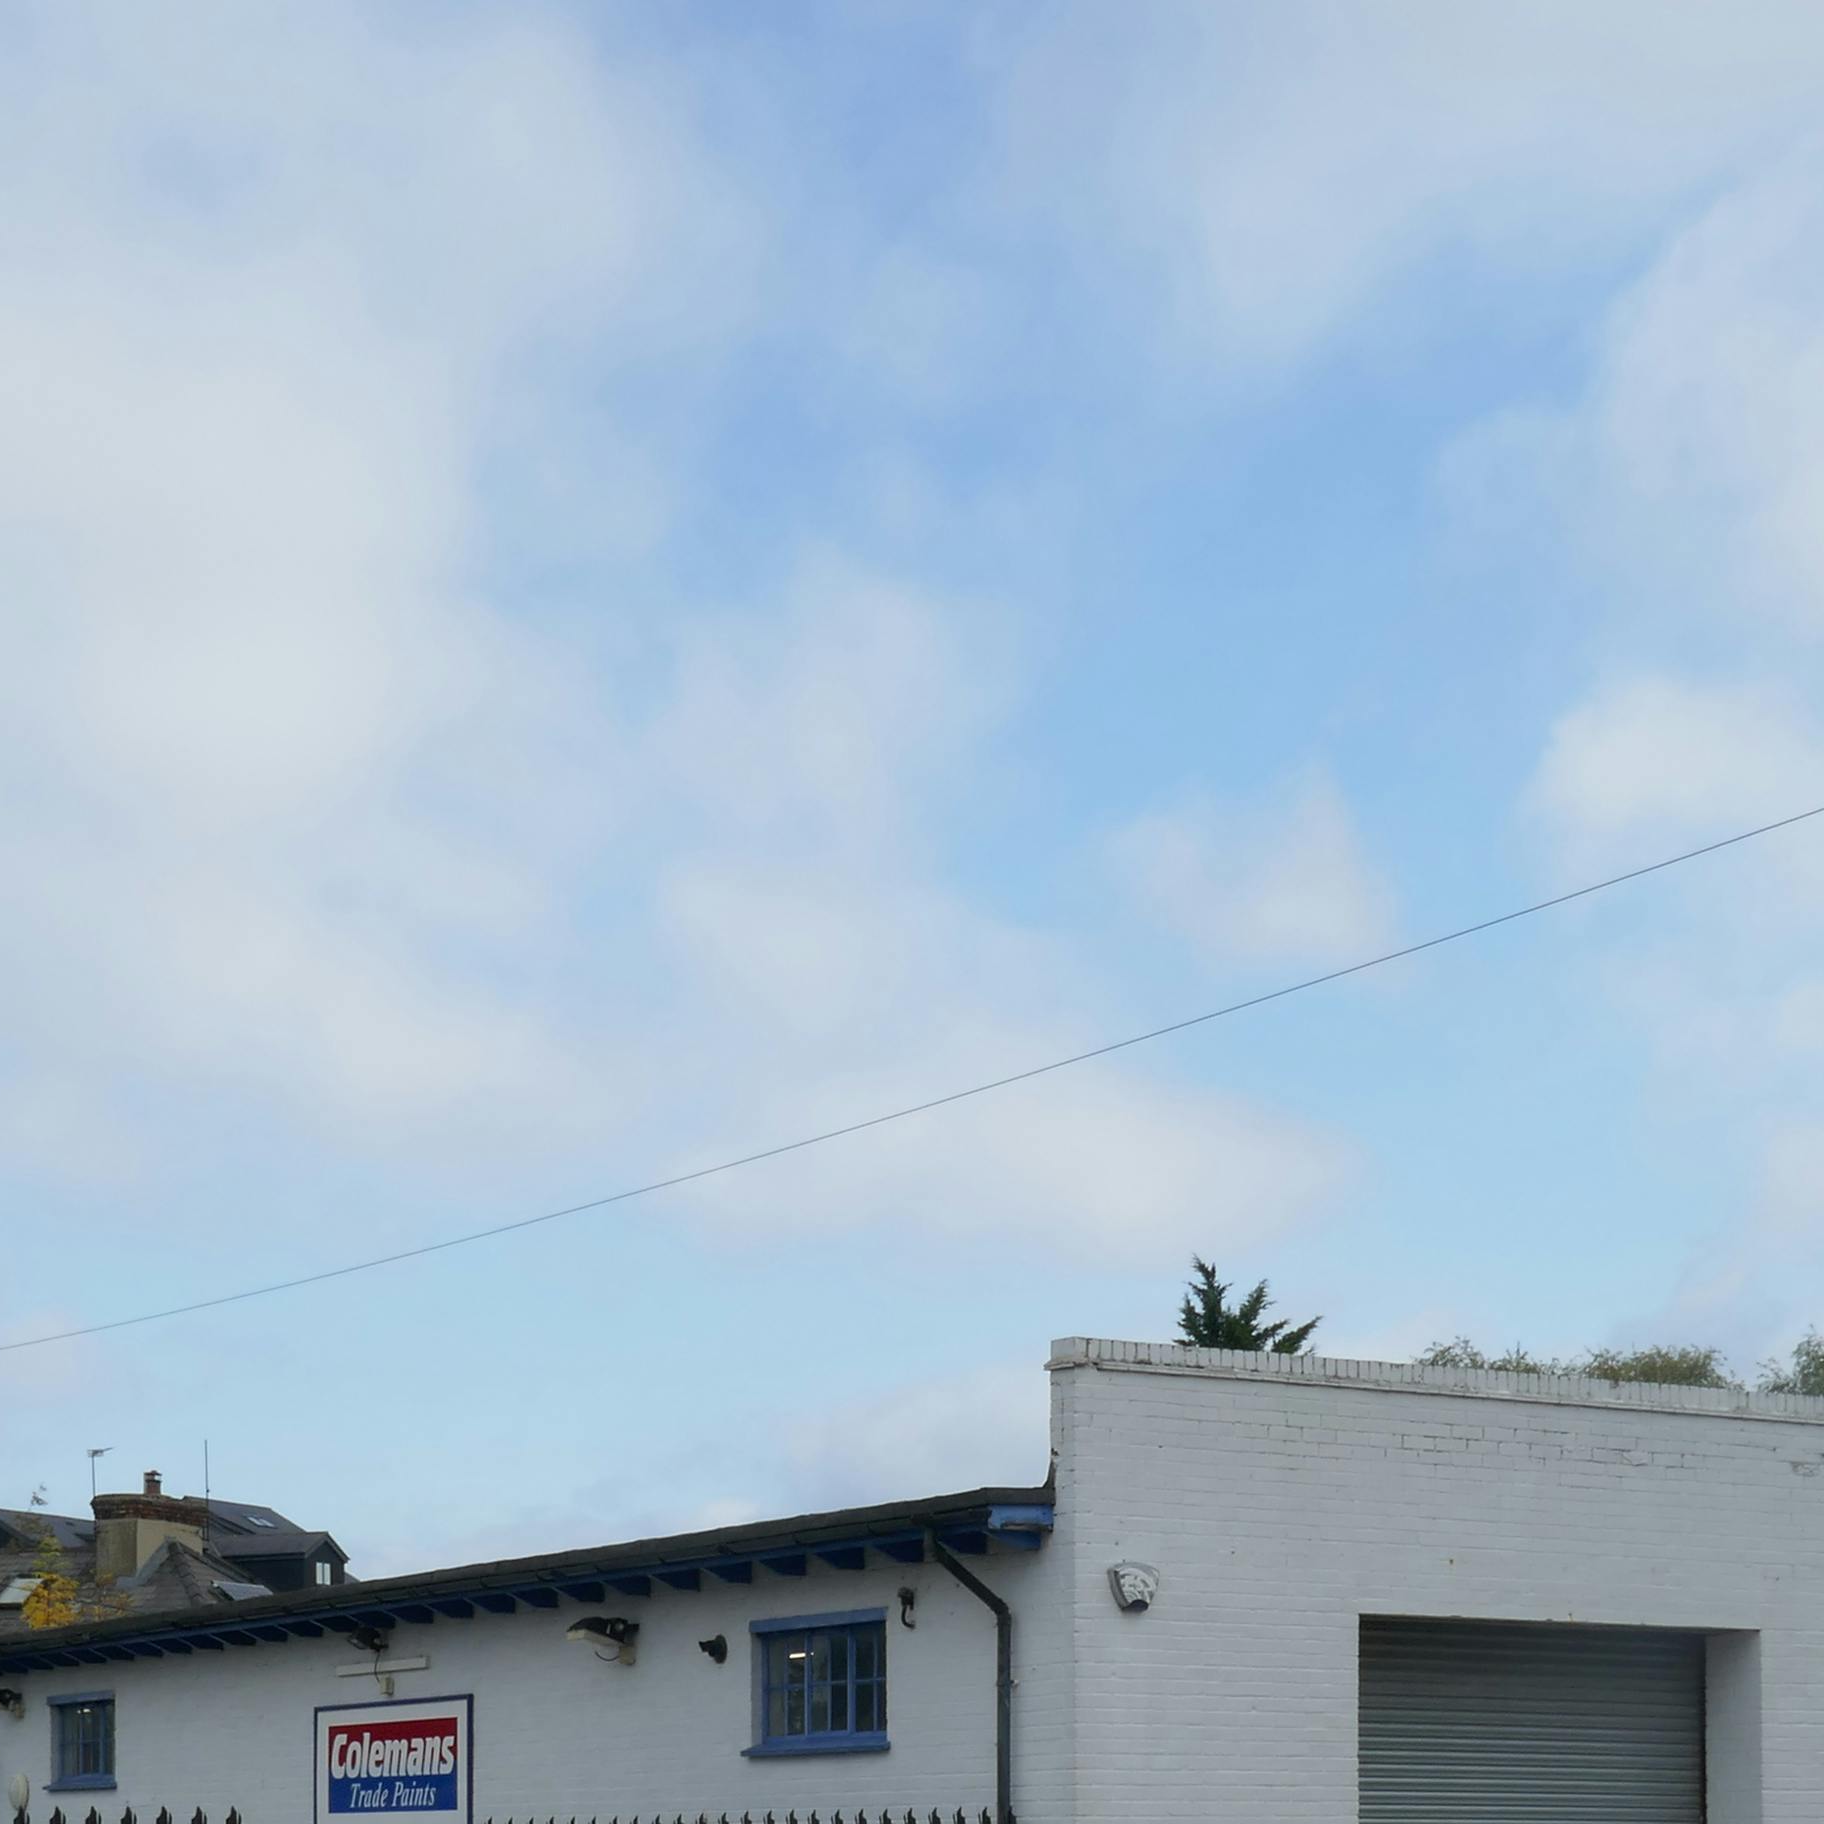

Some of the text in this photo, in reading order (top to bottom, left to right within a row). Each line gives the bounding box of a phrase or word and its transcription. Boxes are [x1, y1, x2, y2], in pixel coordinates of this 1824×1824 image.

[331, 1732, 455, 1779] Colemans
[349, 1781, 436, 1808] Trade Paints
